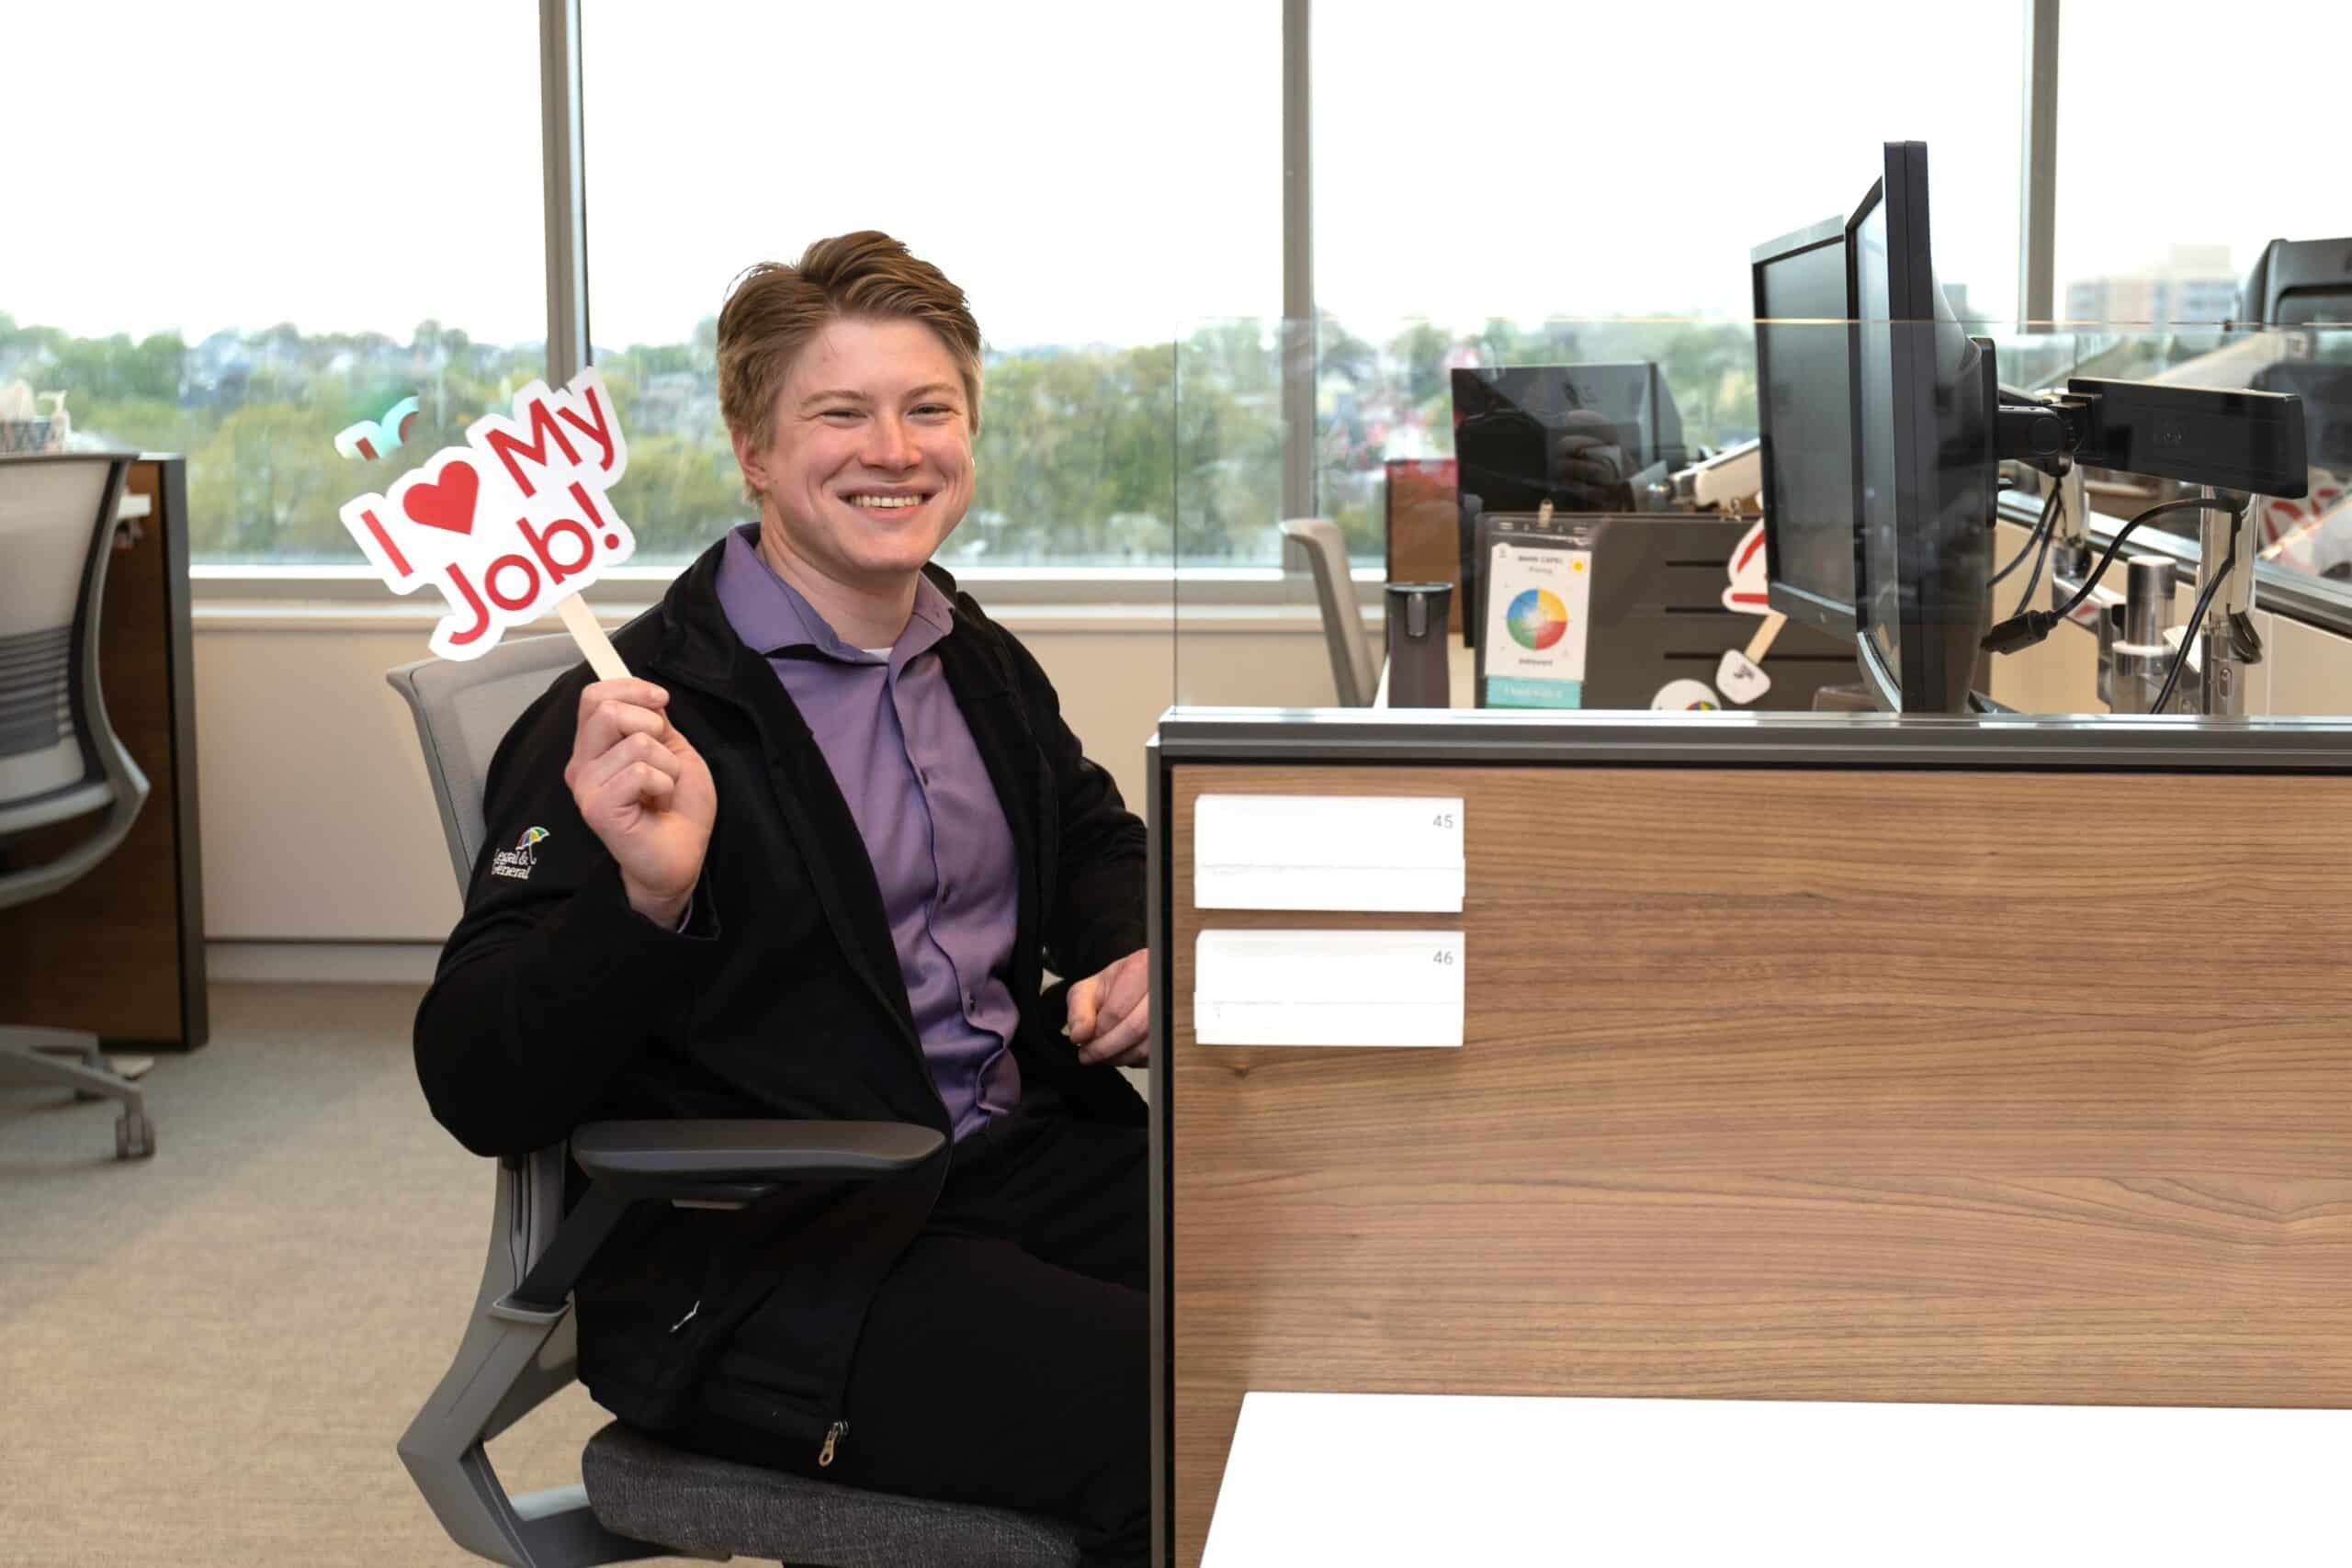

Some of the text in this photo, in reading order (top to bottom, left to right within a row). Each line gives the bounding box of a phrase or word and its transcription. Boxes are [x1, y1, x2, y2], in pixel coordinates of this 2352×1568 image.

[360, 387, 615, 578] I My
[446, 481, 620, 646] Job!
[1433, 813, 1454, 829] 45
[1433, 950, 1454, 965] 46
